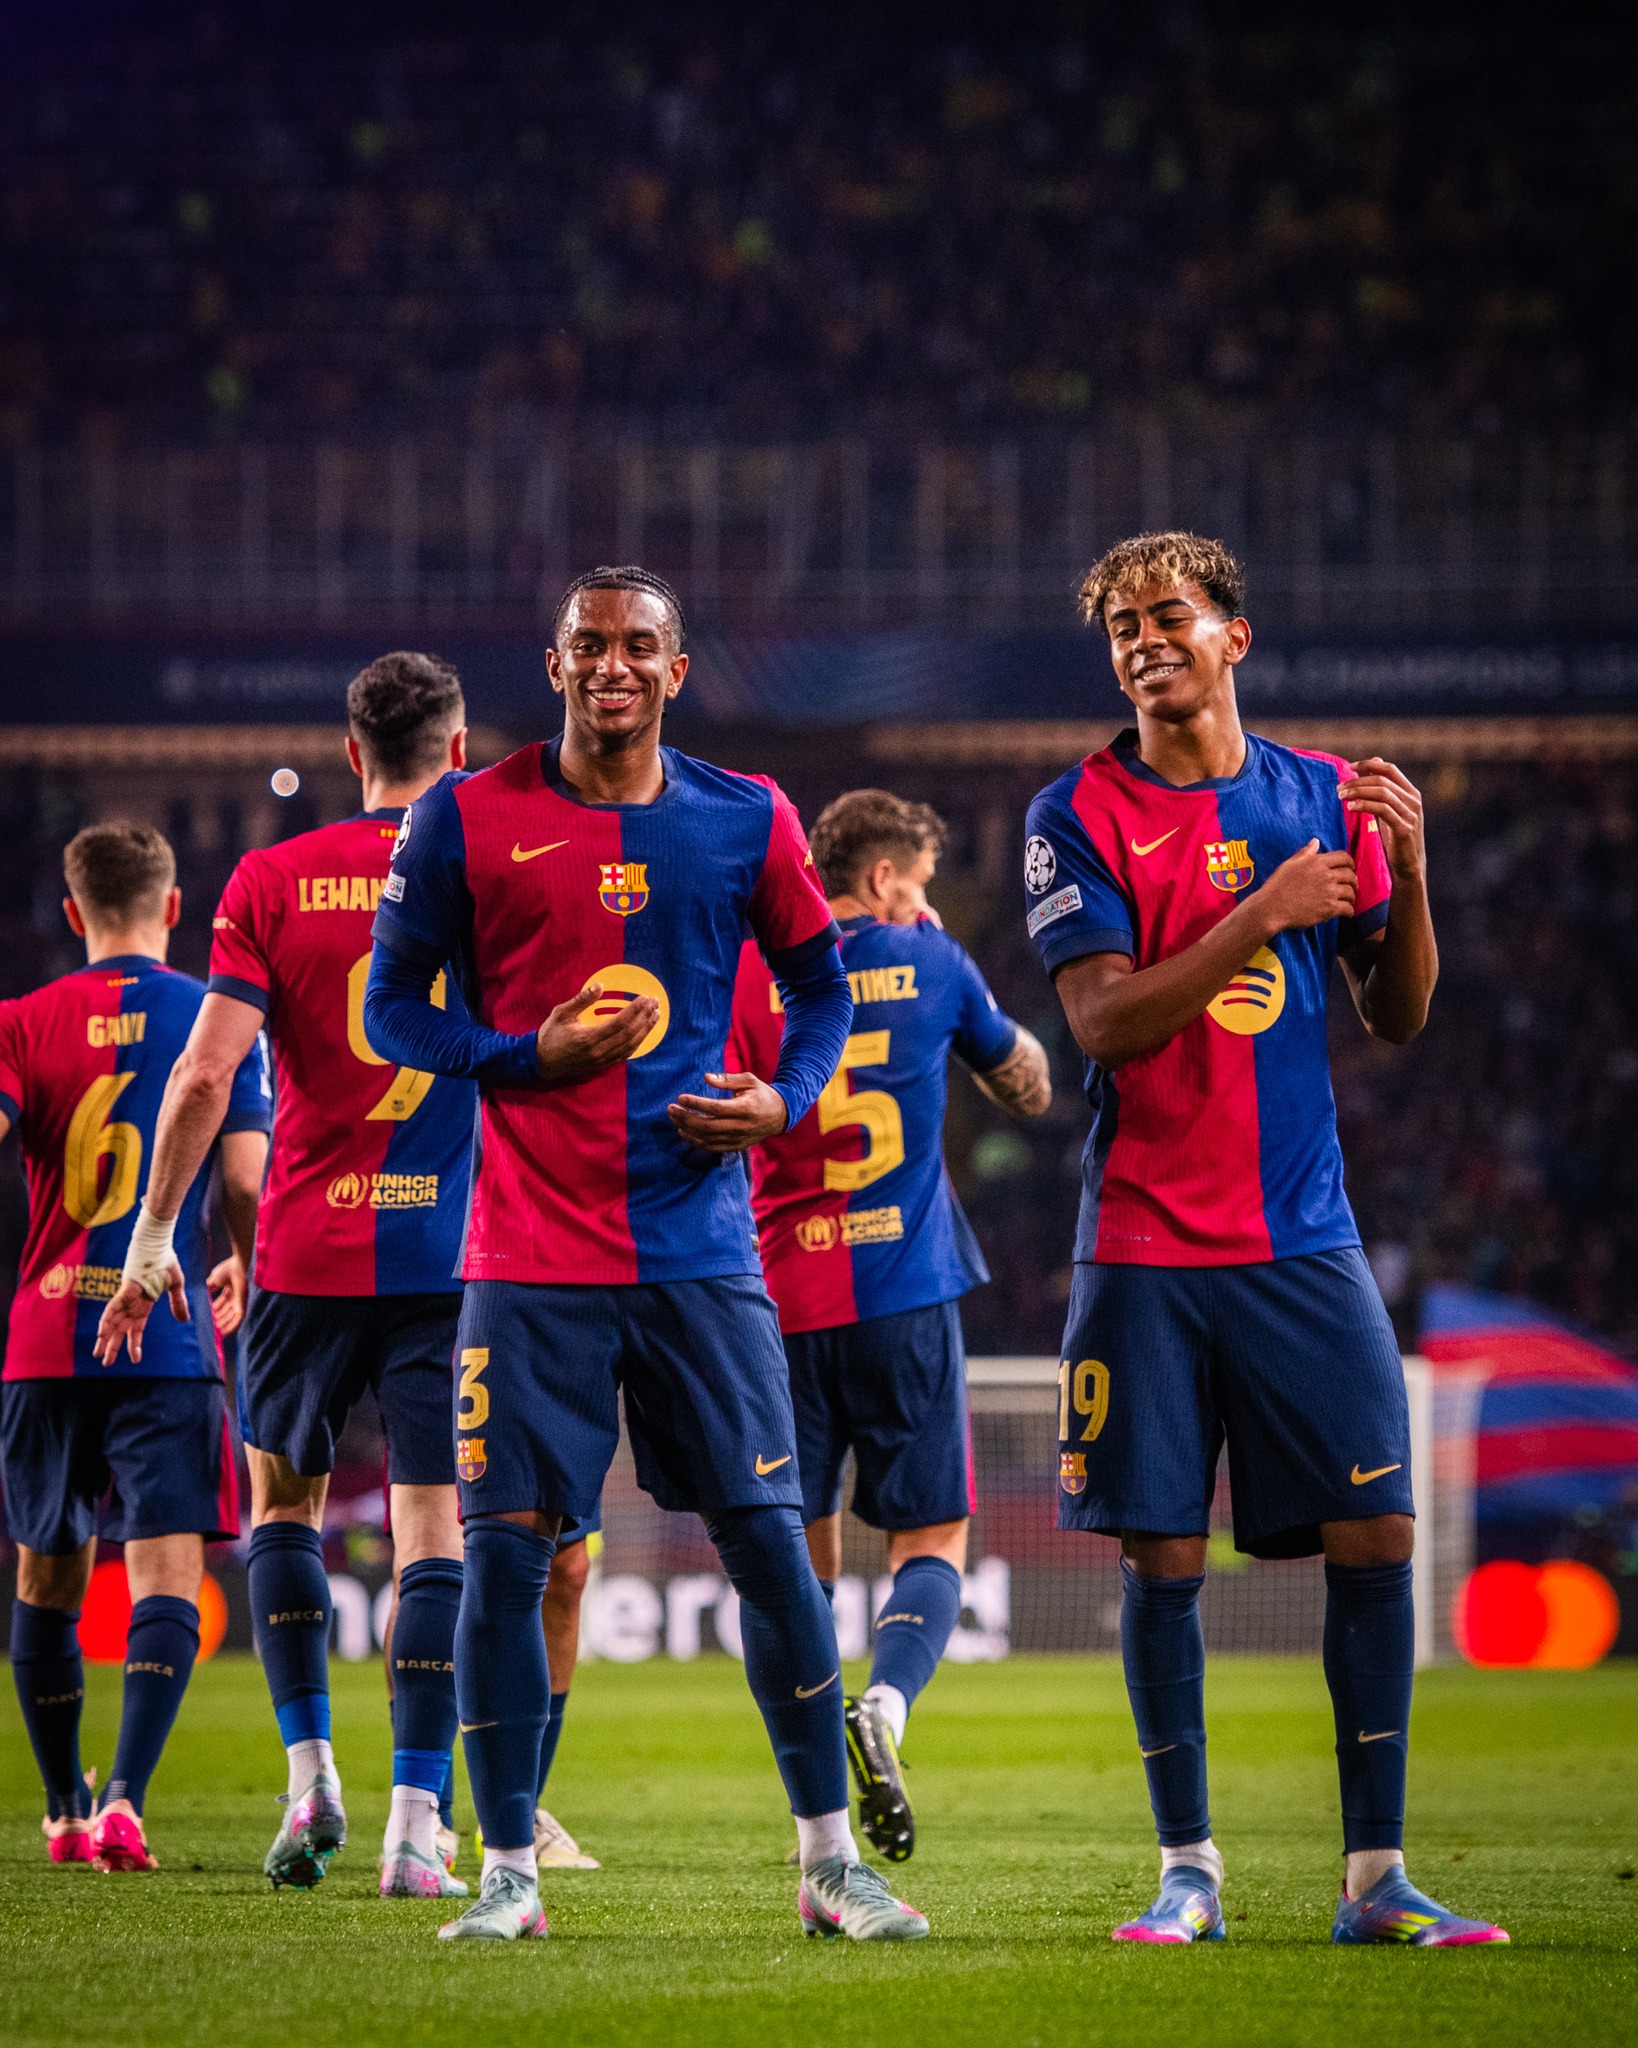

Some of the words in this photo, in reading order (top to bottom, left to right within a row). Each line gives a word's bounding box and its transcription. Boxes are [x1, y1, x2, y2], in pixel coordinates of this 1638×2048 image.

[299, 877, 388, 912] LEWAN
[1028, 892, 1078, 929] FOUNDATION
[87, 1011, 147, 1049] GAVI
[817, 1029, 905, 1191] 5
[63, 1071, 142, 1228] 6
[369, 1187, 438, 1204] ACNUR
[371, 1173, 439, 1190] UNHCR
[75, 1264, 124, 1282] UNHC
[457, 1348, 490, 1430] 3
[1058, 1360, 1110, 1441] 19
